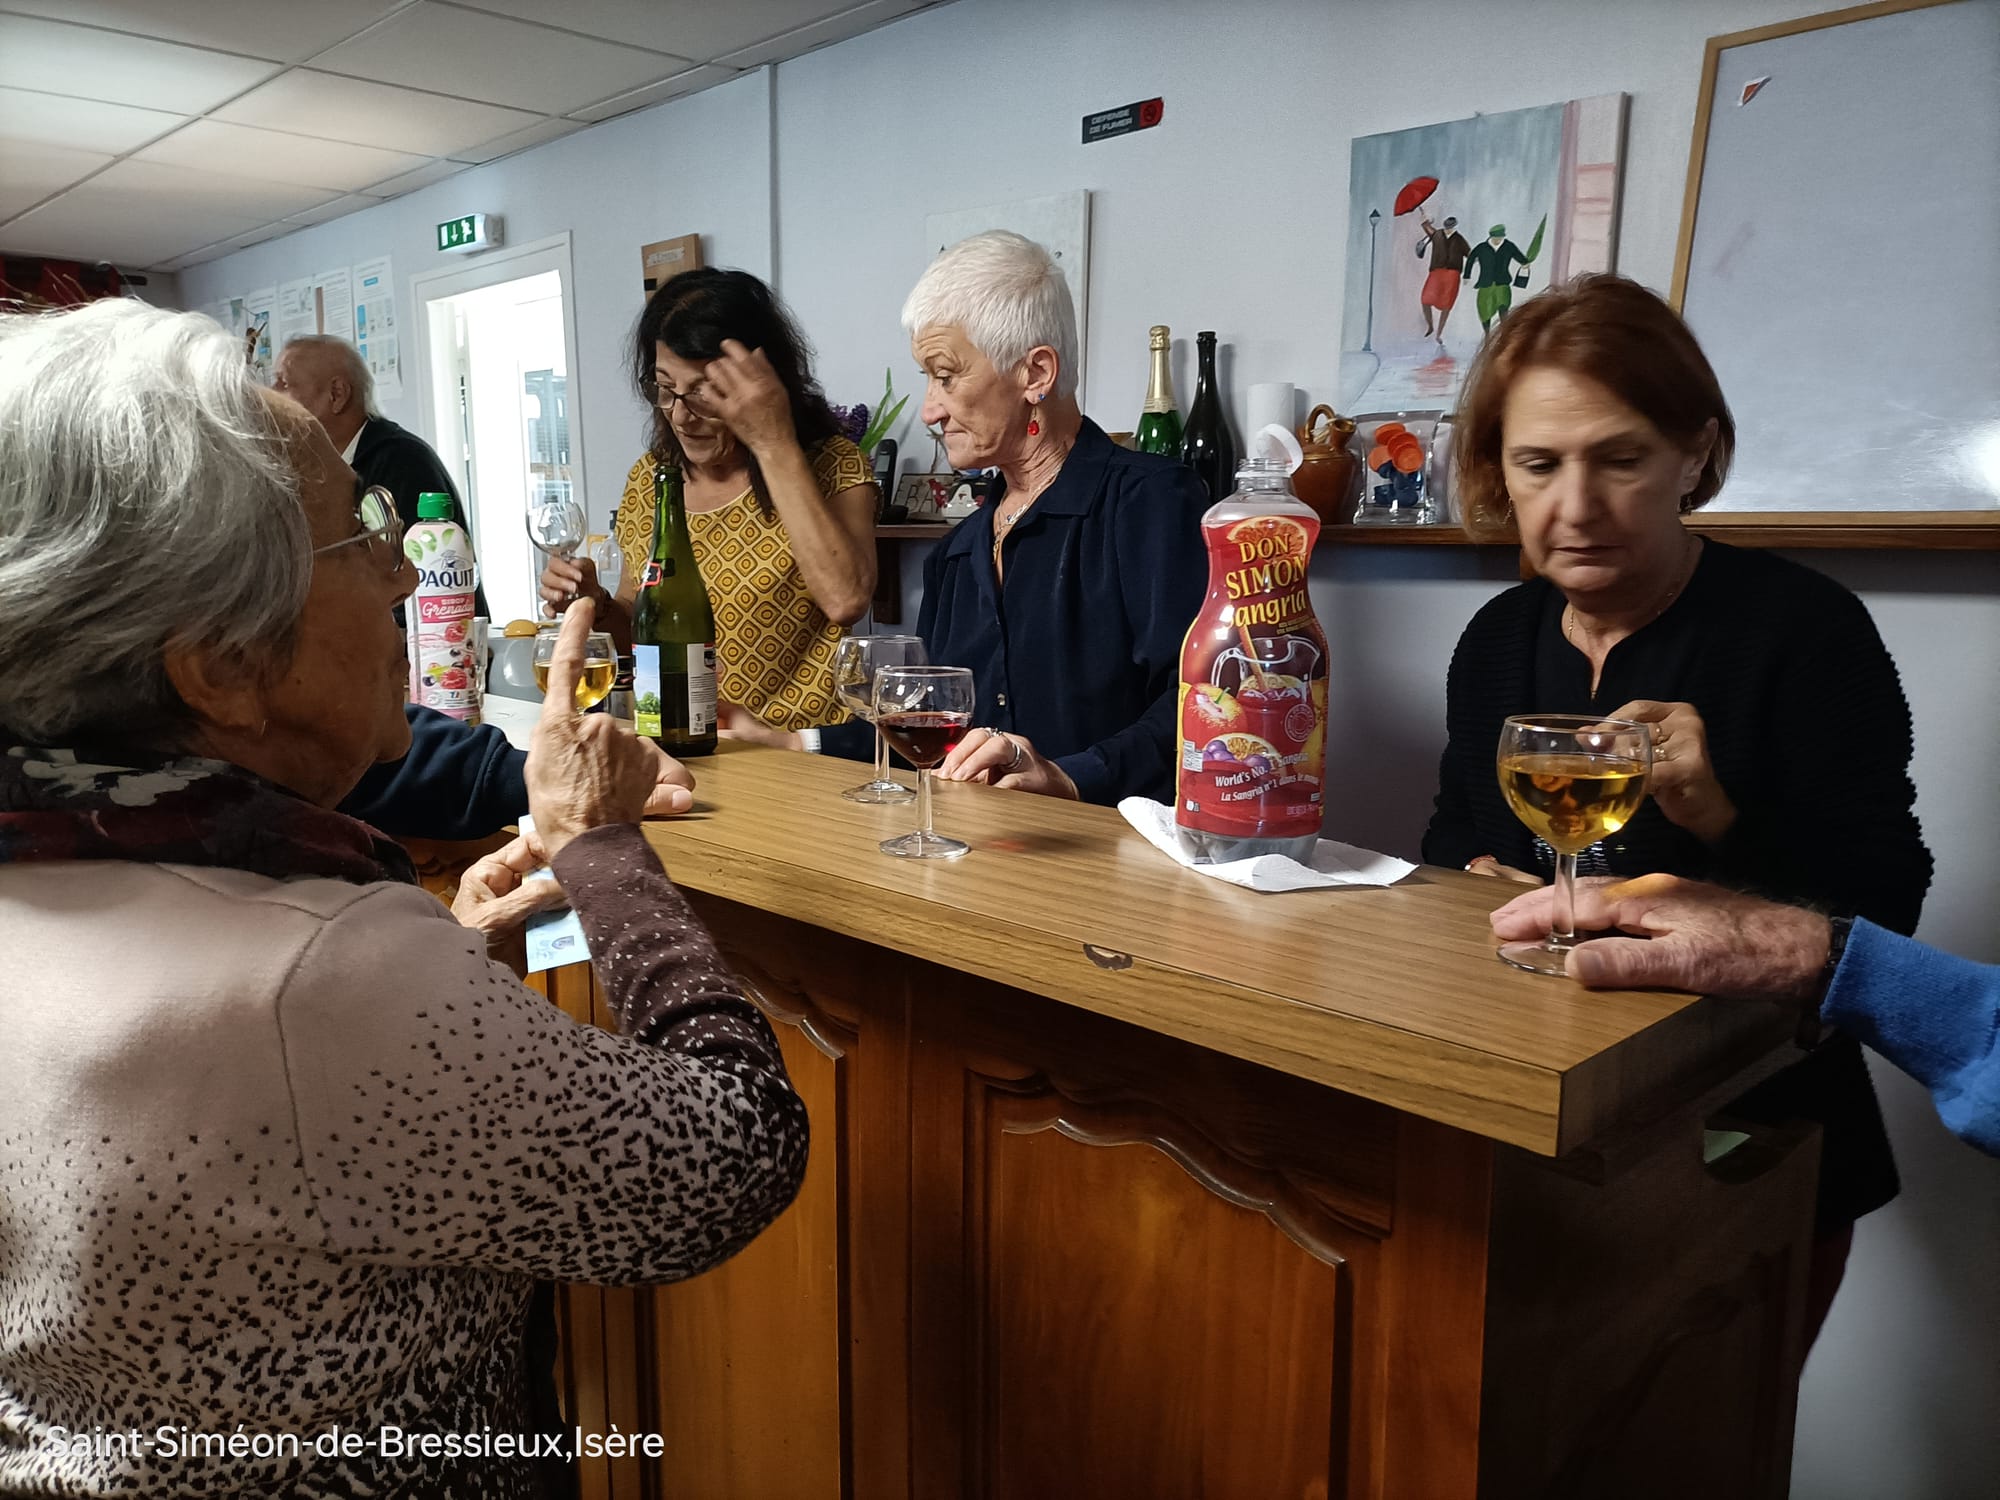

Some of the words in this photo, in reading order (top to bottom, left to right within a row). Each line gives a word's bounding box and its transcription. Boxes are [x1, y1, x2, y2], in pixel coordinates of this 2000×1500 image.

[1239, 533, 1291, 564] DON
[1225, 553, 1307, 600] SIMON
[1215, 771, 1251, 787] World's
[1251, 765, 1268, 779] No.
[1221, 791, 1231, 801] La
